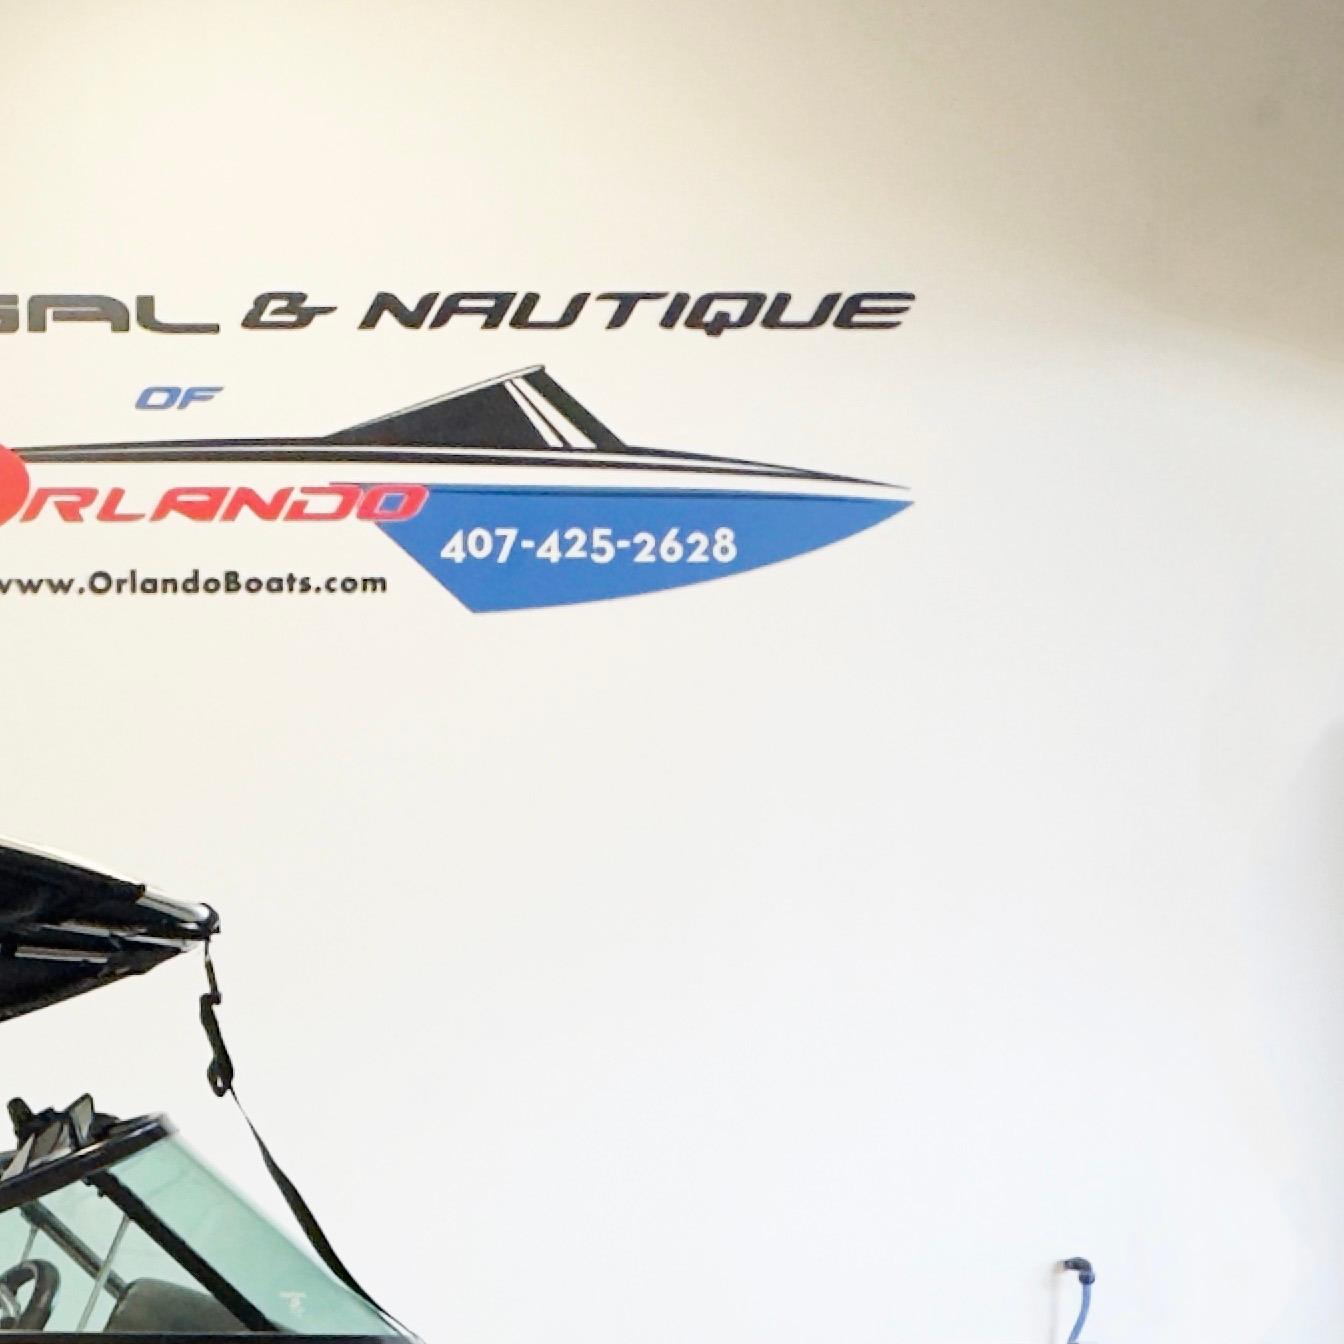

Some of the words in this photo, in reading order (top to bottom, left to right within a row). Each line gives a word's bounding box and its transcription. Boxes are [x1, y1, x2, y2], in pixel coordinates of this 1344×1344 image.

[240, 291, 338, 330] &
[357, 291, 916, 337] NAUTIQUE
[134, 386, 225, 410] OF
[439, 526, 738, 564] 407-425-2628
